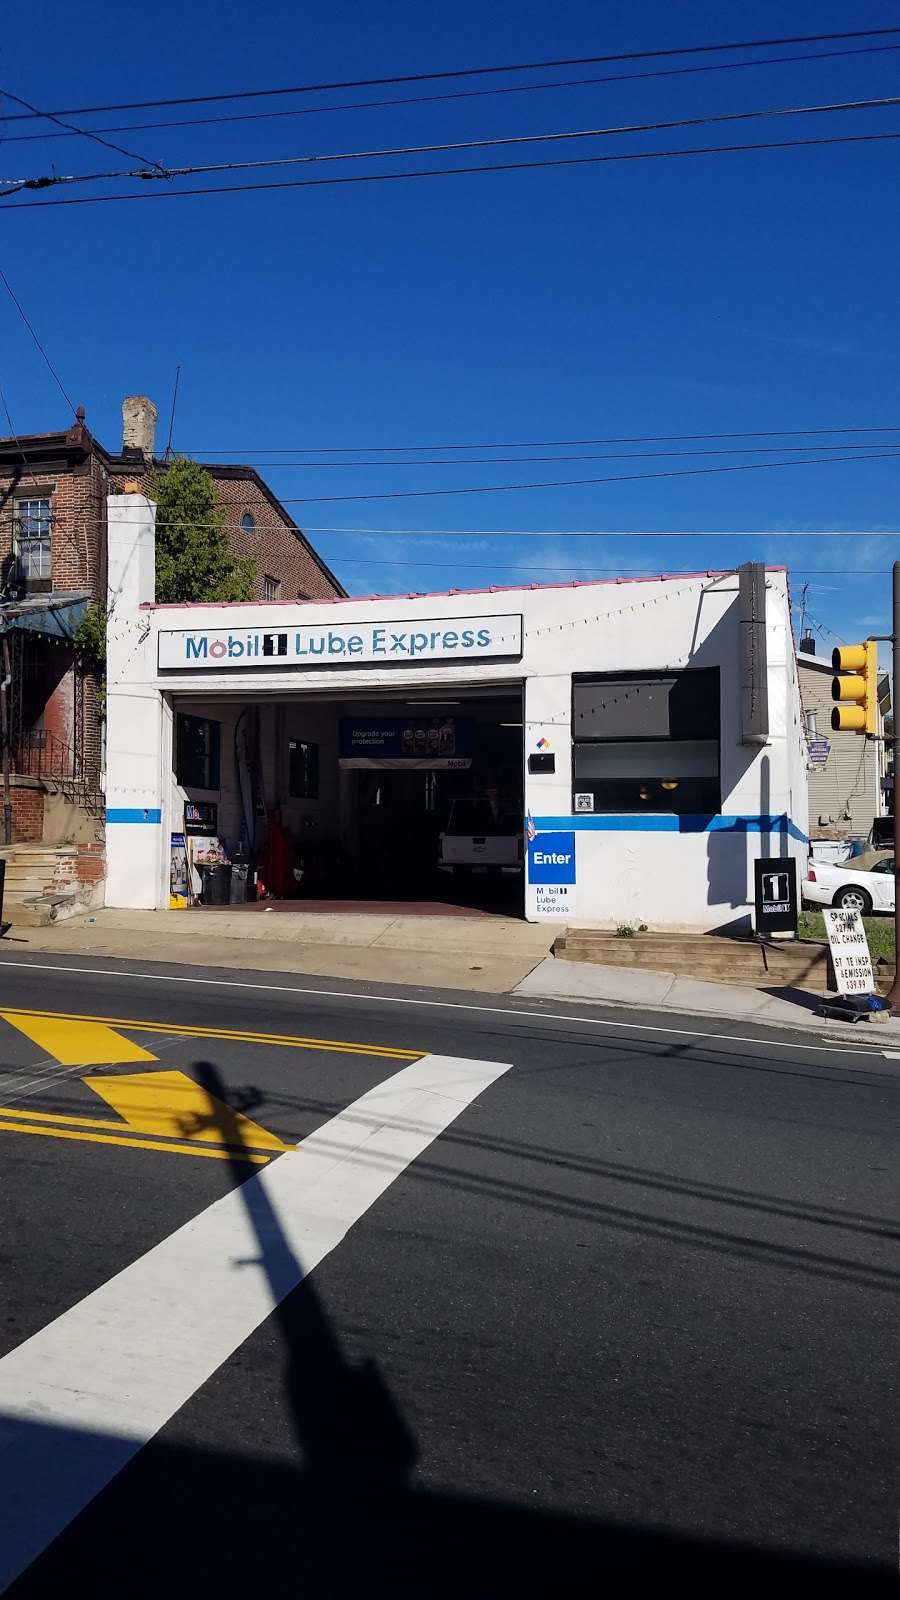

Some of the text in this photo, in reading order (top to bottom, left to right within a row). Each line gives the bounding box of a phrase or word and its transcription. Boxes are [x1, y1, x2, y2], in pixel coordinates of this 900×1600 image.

[185, 635, 259, 659] Mobil
[295, 631, 364, 656] Lube
[372, 626, 491, 656] Express
[352, 730, 380, 738] Upgrade
[533, 852, 571, 864] Enter
[536, 887, 559, 895] Mbil
[769, 876, 779, 900] 1
[536, 896, 556, 904] Lube
[536, 905, 569, 914] Express
[830, 934, 864, 944] OIL CHANGE
